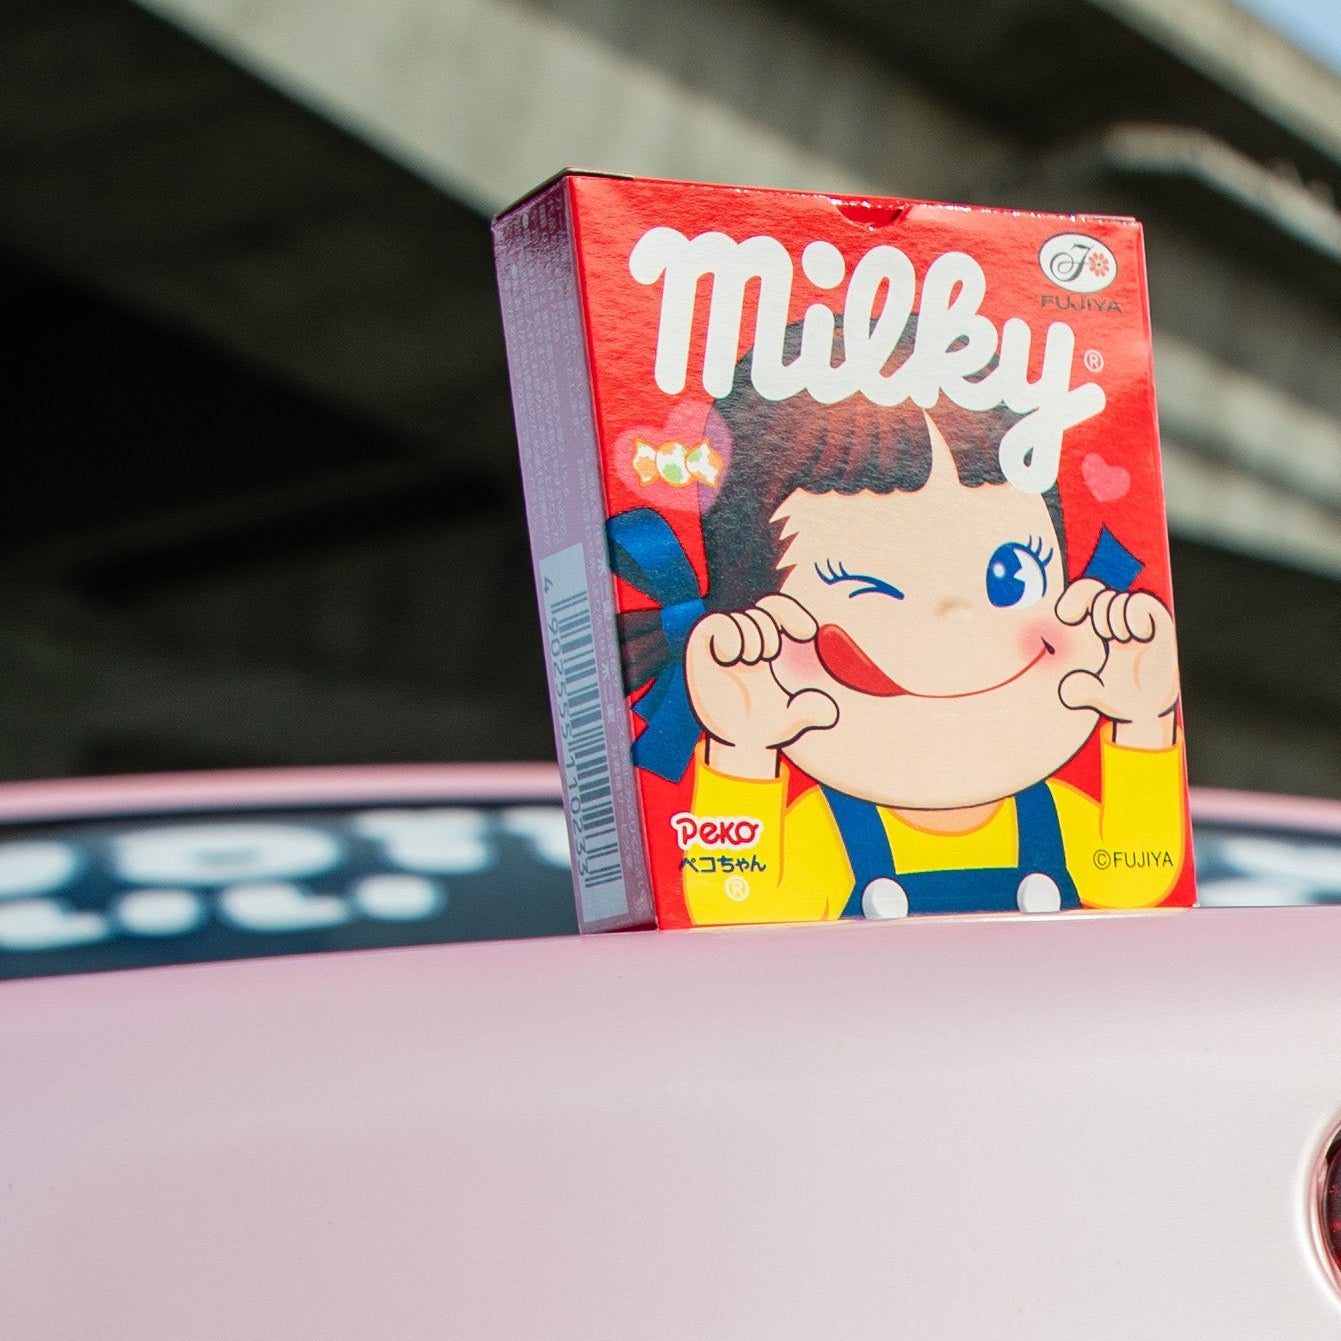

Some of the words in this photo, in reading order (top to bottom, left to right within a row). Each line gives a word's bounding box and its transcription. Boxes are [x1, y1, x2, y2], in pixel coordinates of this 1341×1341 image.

[1040, 294, 1123, 314] FUJIYA
[629, 227, 1106, 493] Milky
[679, 853, 767, 874] ペコちゃん
